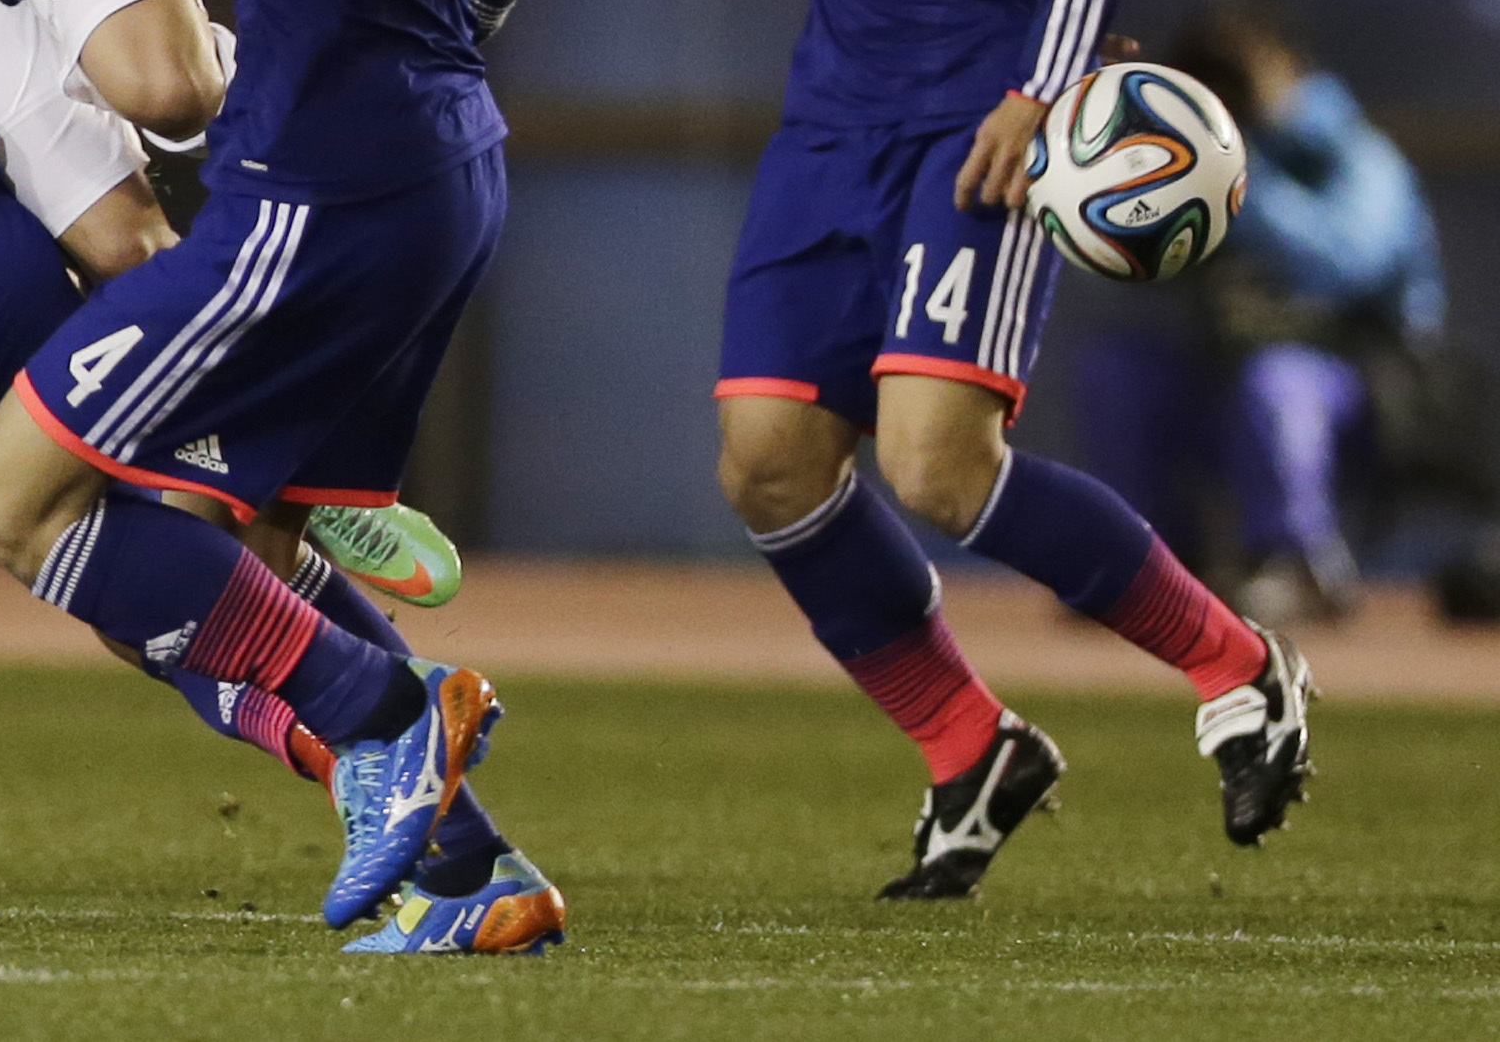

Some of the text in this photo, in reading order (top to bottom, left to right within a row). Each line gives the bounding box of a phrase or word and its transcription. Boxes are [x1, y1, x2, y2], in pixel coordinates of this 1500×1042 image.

[895, 243, 975, 344] 14
[66, 324, 146, 408] 4
[174, 448, 229, 475] adidas
